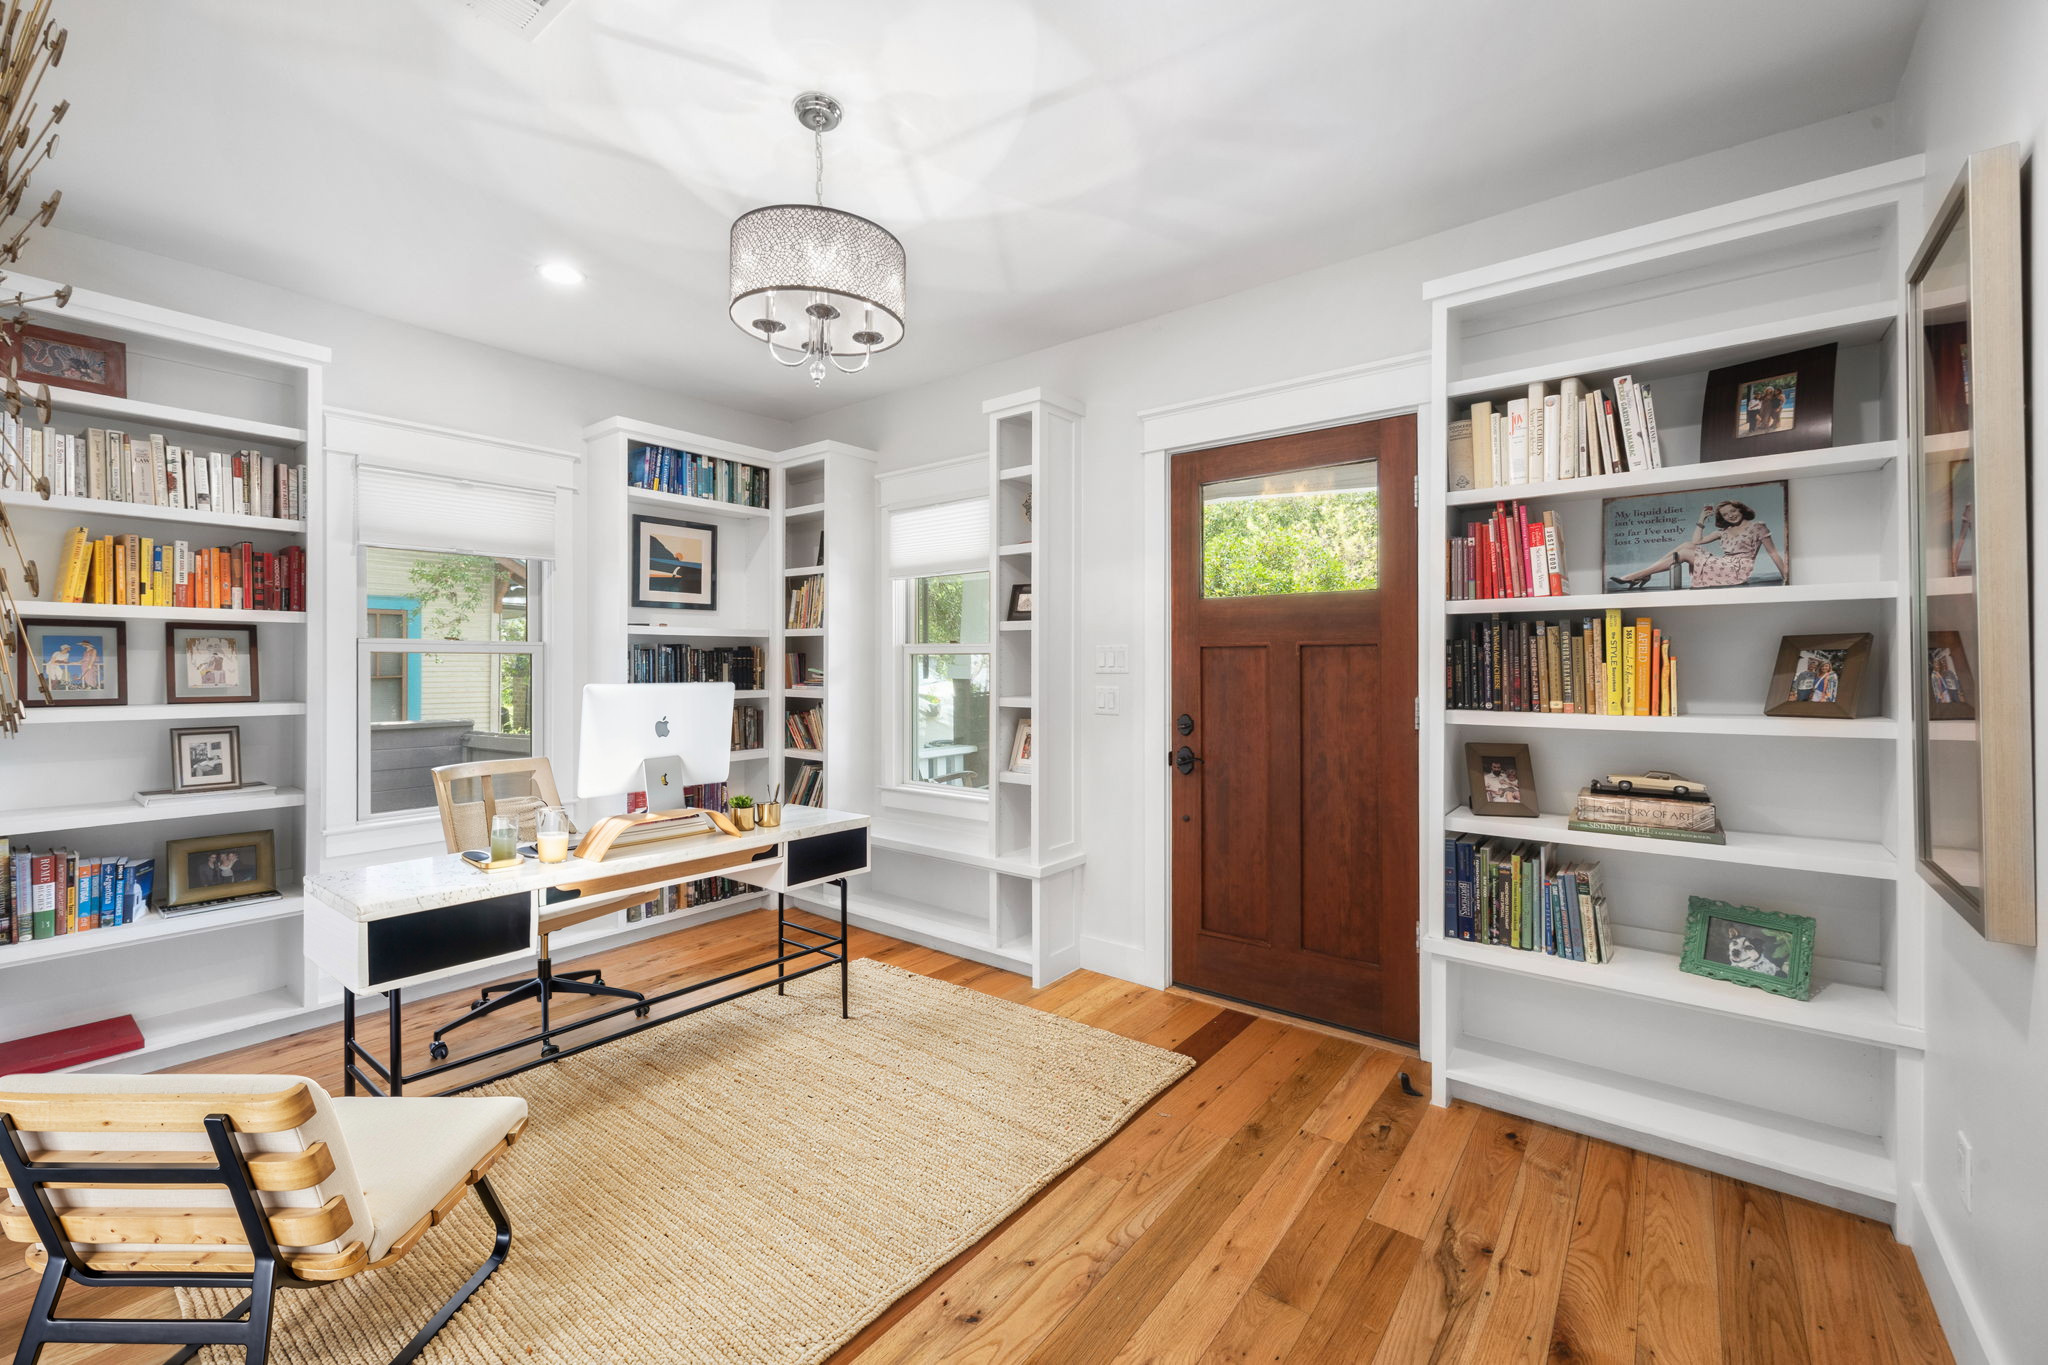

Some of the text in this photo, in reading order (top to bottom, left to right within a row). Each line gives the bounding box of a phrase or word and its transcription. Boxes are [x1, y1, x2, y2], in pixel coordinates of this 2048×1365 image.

[1620, 402, 1631, 427] GARDEN
[1624, 428, 1636, 457] ALMANAC
[1615, 506, 1684, 519] My liquid diet
[1546, 531, 1555, 546] JUST
[1642, 536, 1675, 544] weeks.
[1663, 526, 1686, 535] only
[1638, 632, 1648, 663] AFIELD
[1563, 660, 1571, 692] CREAMERY
[1606, 808, 1650, 817] HISTORY
[1652, 809, 1667, 818] OF
[1670, 811, 1690, 821] ART
[1589, 822, 1619, 831] SISTINE
[1619, 824, 1651, 834] CHAPEL
[40, 859, 50, 883] ROME
[80, 878, 89, 904] PORTUGAL
[103, 875, 114, 904] Argentina
[1459, 883, 1468, 915] BIRTHDAYS
